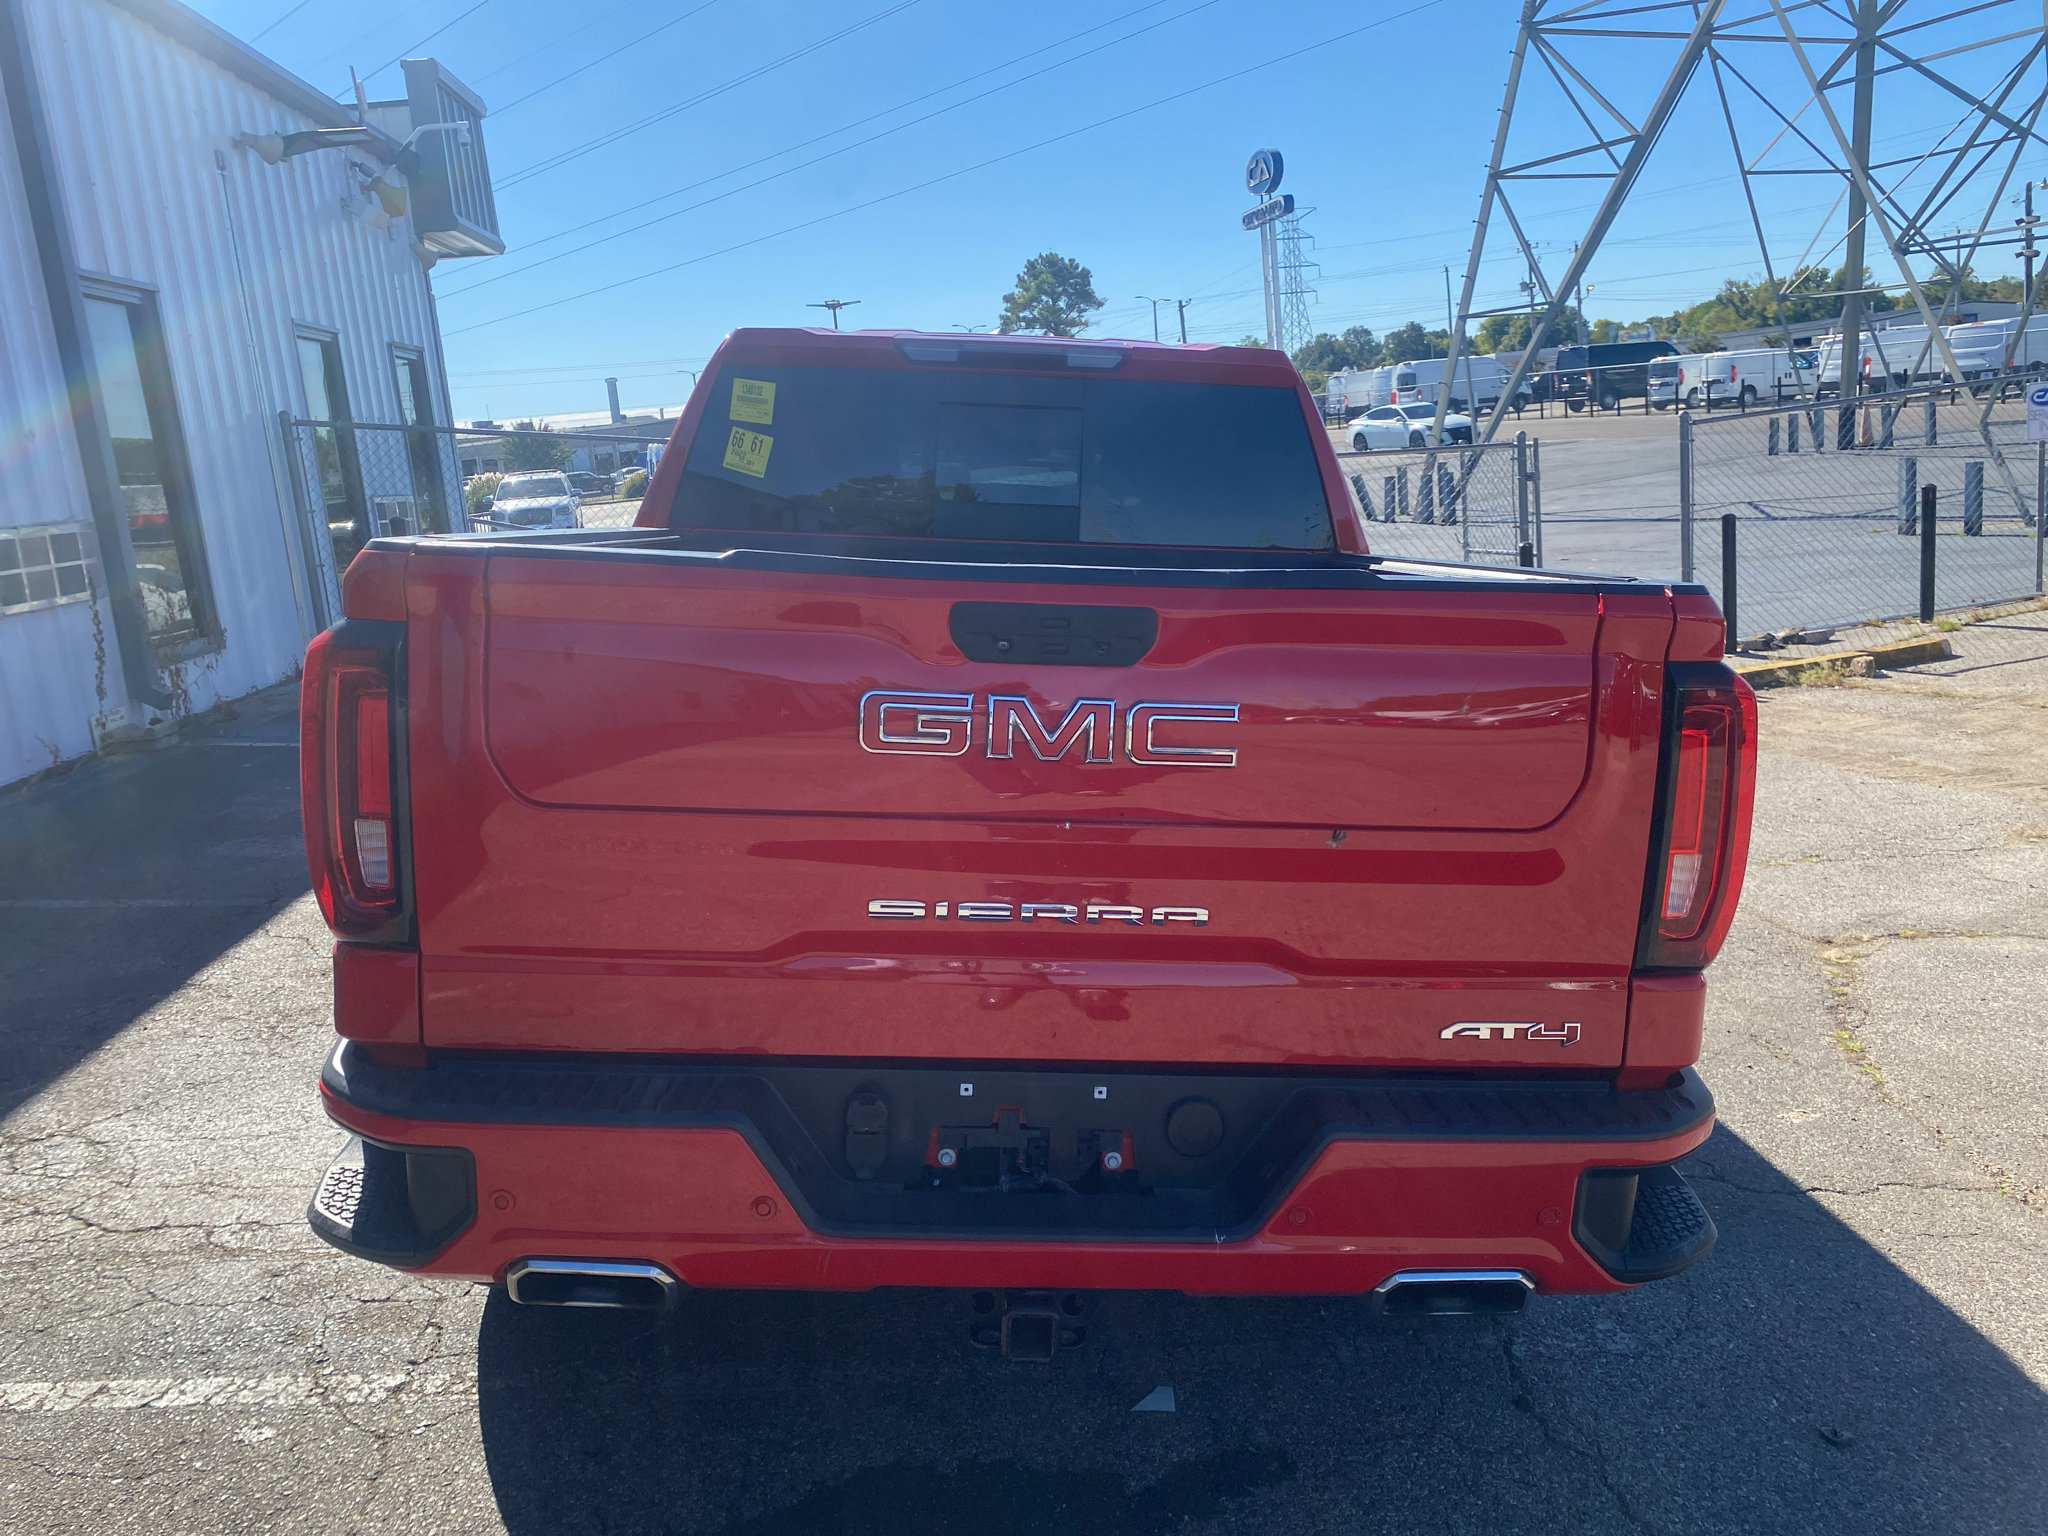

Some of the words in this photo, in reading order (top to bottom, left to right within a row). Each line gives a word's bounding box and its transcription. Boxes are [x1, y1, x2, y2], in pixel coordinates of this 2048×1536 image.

[731, 430, 745, 448] 66
[750, 435, 764, 454] 61
[859, 690, 1240, 767] GMC
[868, 900, 1209, 926] SIERRA
[1440, 1022, 1581, 1047] AT4
